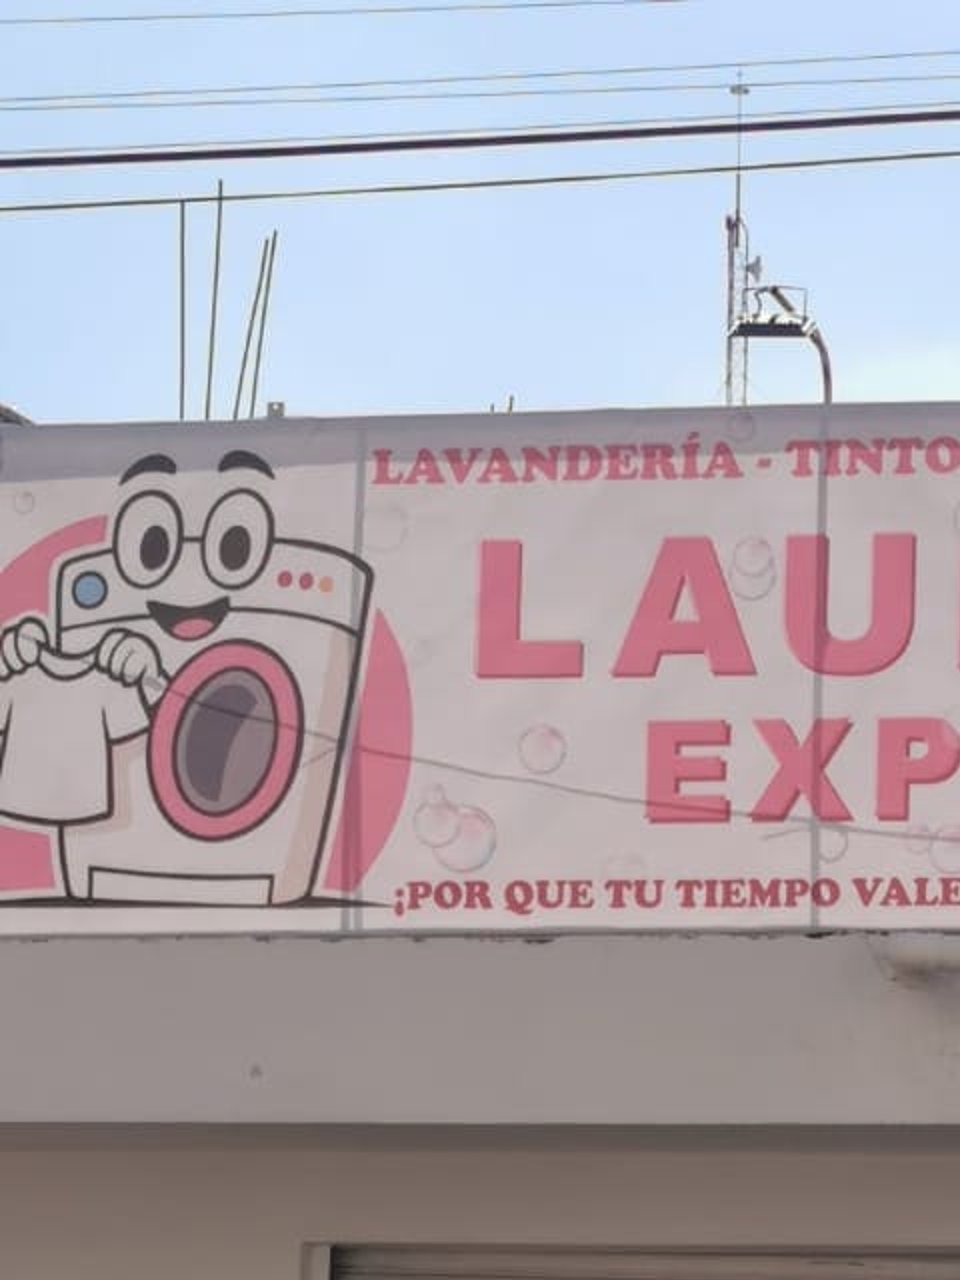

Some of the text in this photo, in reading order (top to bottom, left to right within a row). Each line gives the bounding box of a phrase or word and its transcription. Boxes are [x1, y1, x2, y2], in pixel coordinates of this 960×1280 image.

[371, 432, 742, 487] LAVANDERÍA
[394, 880, 491, 918] ¡POR
[503, 879, 593, 916] QUE
[605, 879, 664, 910] TU
[676, 878, 841, 910] TIEMPO
